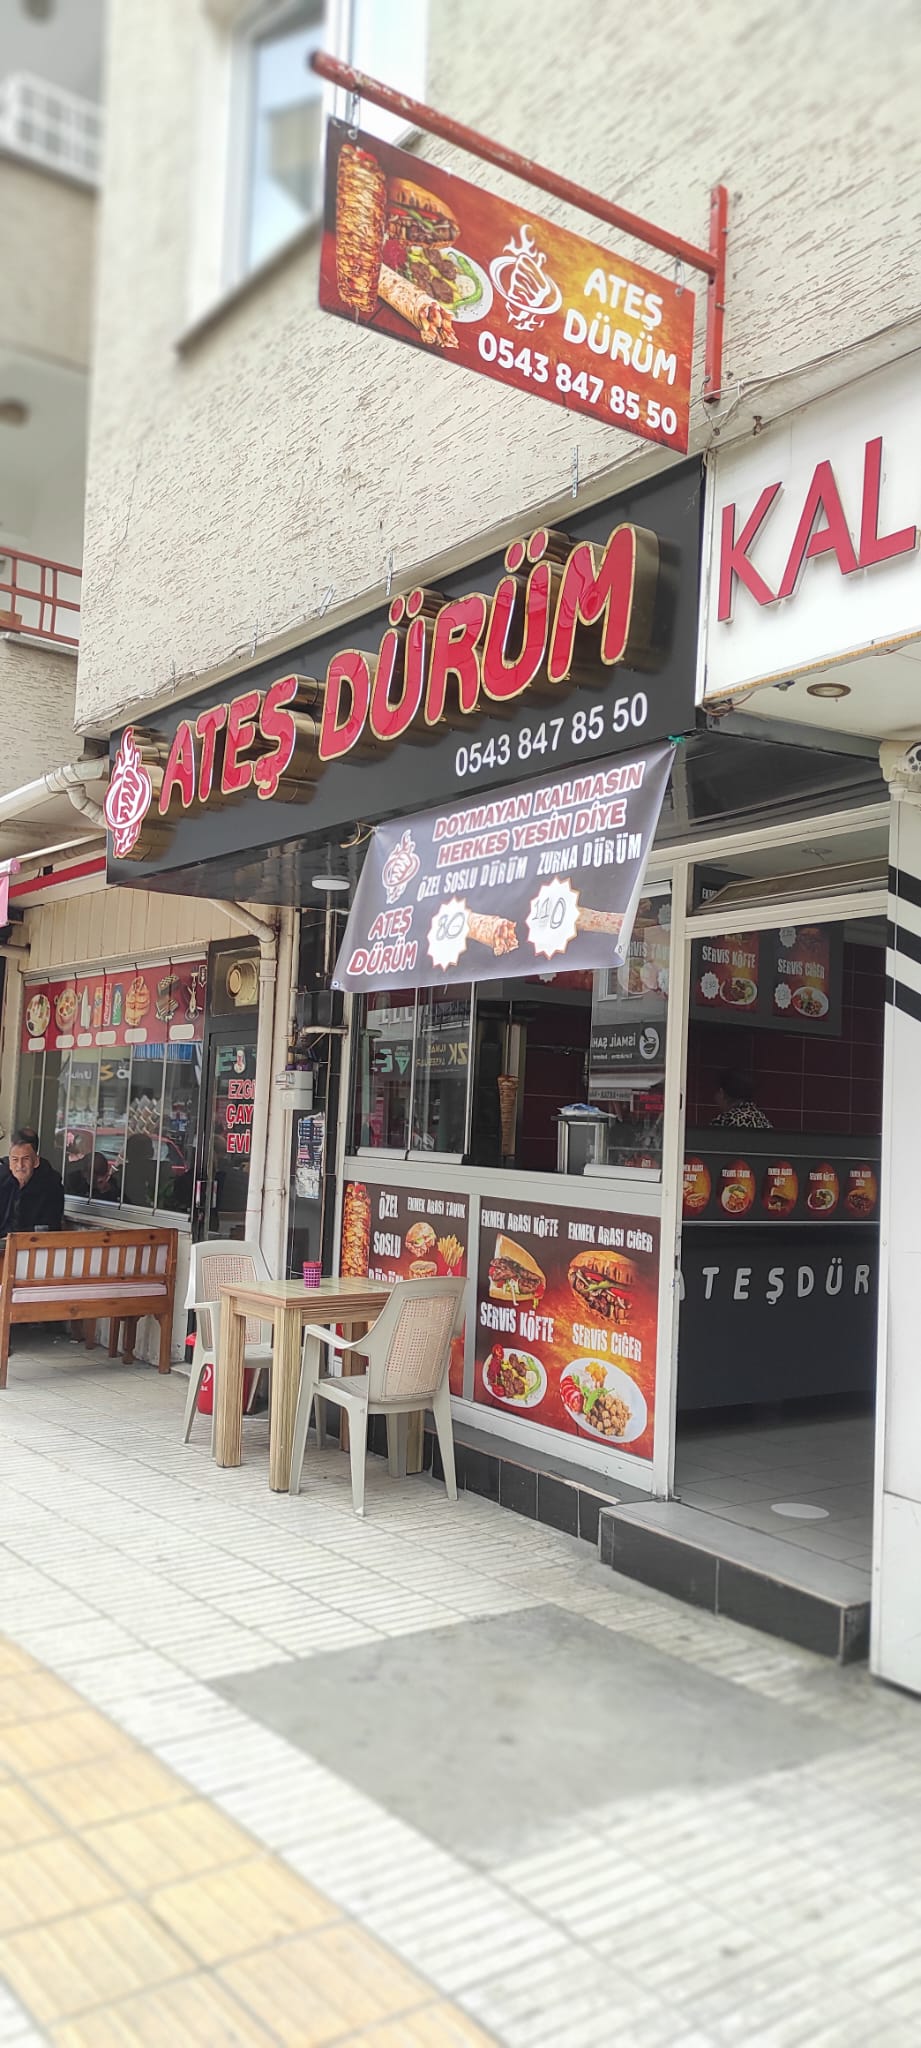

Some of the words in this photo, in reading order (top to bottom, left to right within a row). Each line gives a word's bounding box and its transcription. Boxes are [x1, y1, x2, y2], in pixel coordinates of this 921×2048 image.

[584, 268, 663, 331] ATEŞ
[563, 308, 677, 386] DÜRÜM
[478, 331, 549, 383] 0543
[555, 363, 604, 404] 847
[609, 385, 640, 420] 85
[646, 400, 677, 435] 50
[718, 436, 917, 622] KAL
[158, 674, 299, 816] ATEŞ
[318, 522, 637, 762] DÜRÜM
[455, 734, 511, 776] 0543
[517, 717, 564, 759] 847
[571, 705, 604, 744] 85
[612, 692, 648, 732] 50
[432, 793, 531, 842] DOYMAYAN
[534, 761, 646, 812] KALMASIN
[436, 828, 508, 869] HERKES
[512, 807, 572, 850] YESİN
[574, 798, 626, 835] DİYE
[537, 844, 577, 876] ZURNA
[582, 833, 642, 868] DÜRÜM
[416, 870, 441, 901] ÖZEL
[443, 865, 478, 893] SOSLU
[480, 856, 528, 887] DÜRÜM
[367, 905, 413, 941] ATEŞ
[436, 914, 465, 940] 80
[531, 897, 566, 929] 110
[346, 934, 418, 975] DÜRÜM
[732, 950, 756, 969] KÖFTE
[226, 1104, 254, 1128] ÇAY
[226, 1129, 250, 1154] EVİ
[379, 1191, 398, 1220] ÖZEL
[407, 1196, 425, 1213] EKMEK
[427, 1199, 444, 1215] ARASI
[445, 1202, 466, 1219] TAVUK
[481, 1209, 505, 1230] EKMEK
[507, 1212, 531, 1232] ARASI
[533, 1215, 559, 1238] KÖFTE
[373, 1231, 401, 1258] SOSLU
[568, 1221, 595, 1244] EKMEK
[597, 1225, 624, 1247] ARASI
[626, 1228, 653, 1253] CİĞER
[480, 1302, 517, 1333] SERVİS
[519, 1310, 555, 1343] KÖFTE
[572, 1322, 608, 1352] SERVİS
[611, 1332, 642, 1362] CİĞER
